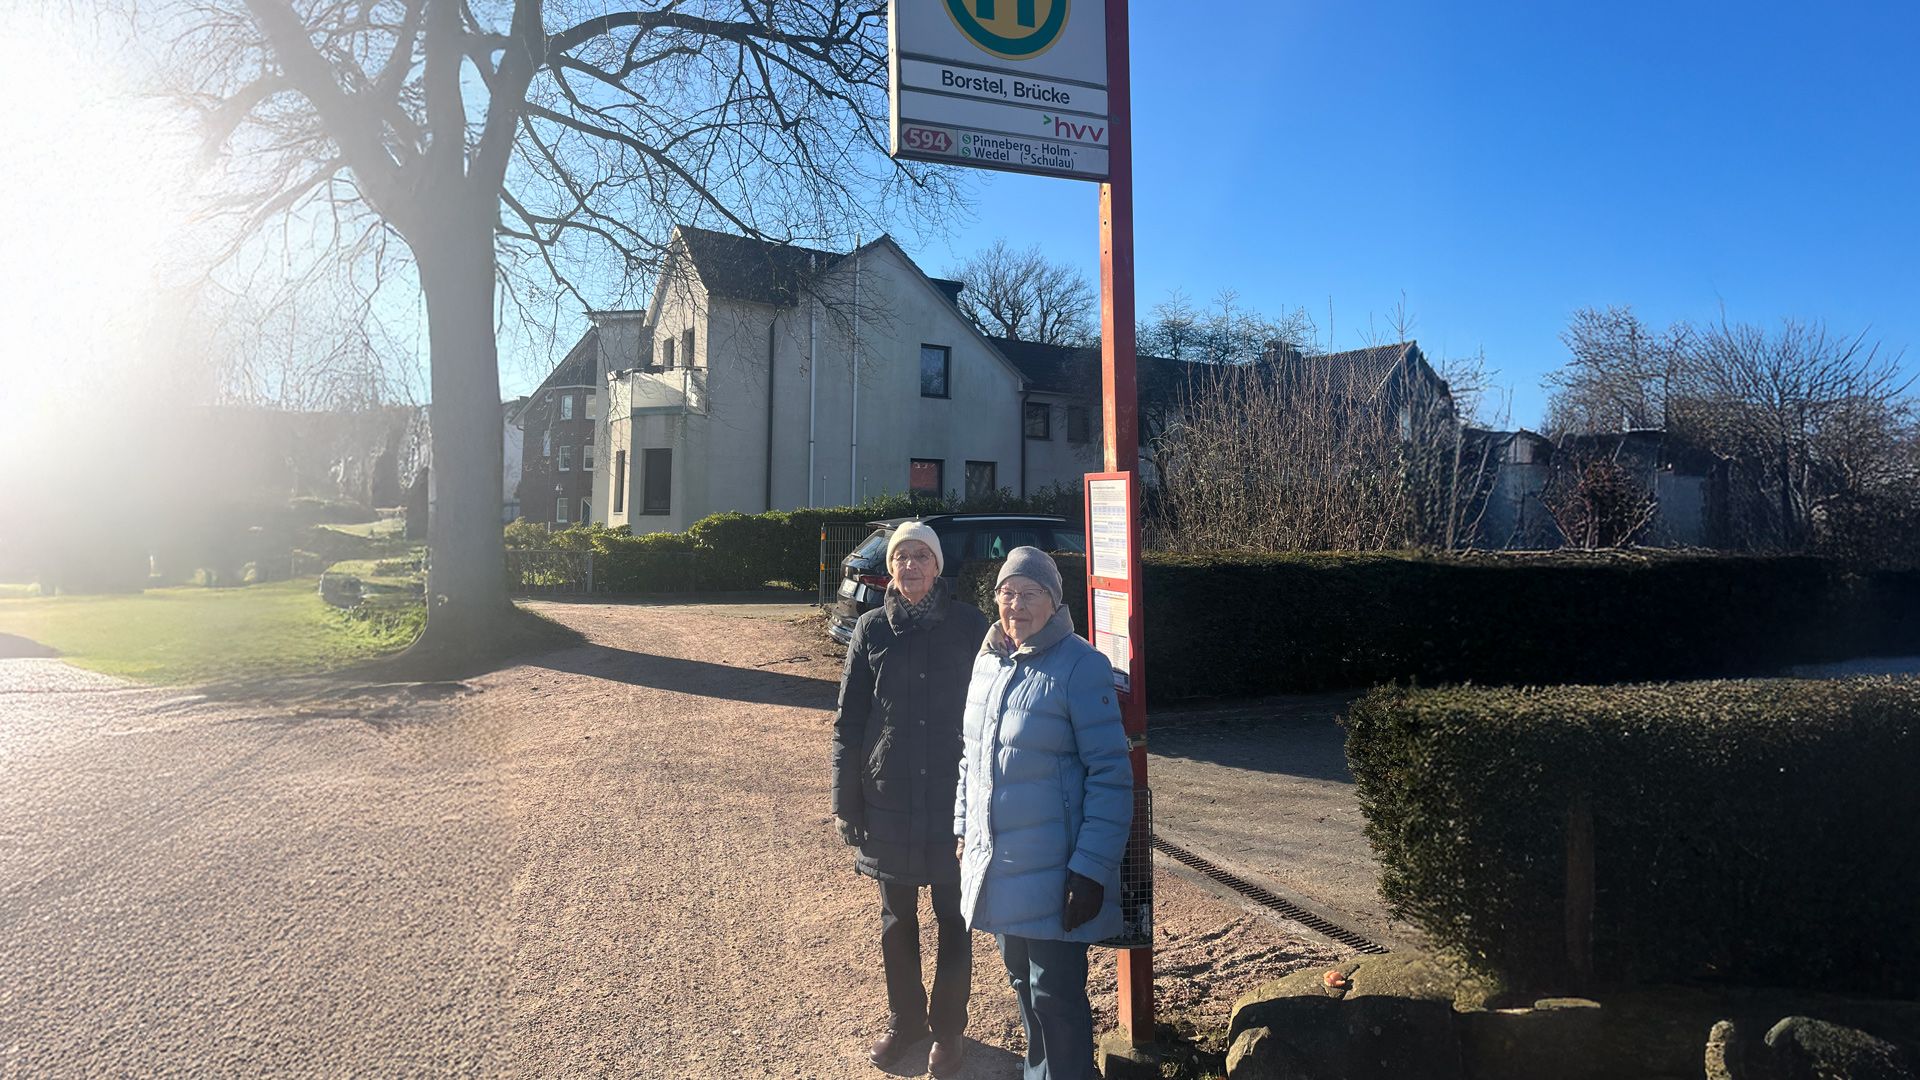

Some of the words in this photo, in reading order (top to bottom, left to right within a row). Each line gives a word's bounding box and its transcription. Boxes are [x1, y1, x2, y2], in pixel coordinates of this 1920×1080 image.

[941, 69, 1008, 98] Borstel,
[1013, 81, 1070, 105] Brücke
[909, 129, 947, 151] 594
[1054, 116, 1105, 142] hvv
[973, 135, 1031, 156] Pinneberg
[1041, 143, 1070, 157] Holm
[974, 147, 1010, 161] Wedel
[1031, 154, 1075, 170] Schulau)
